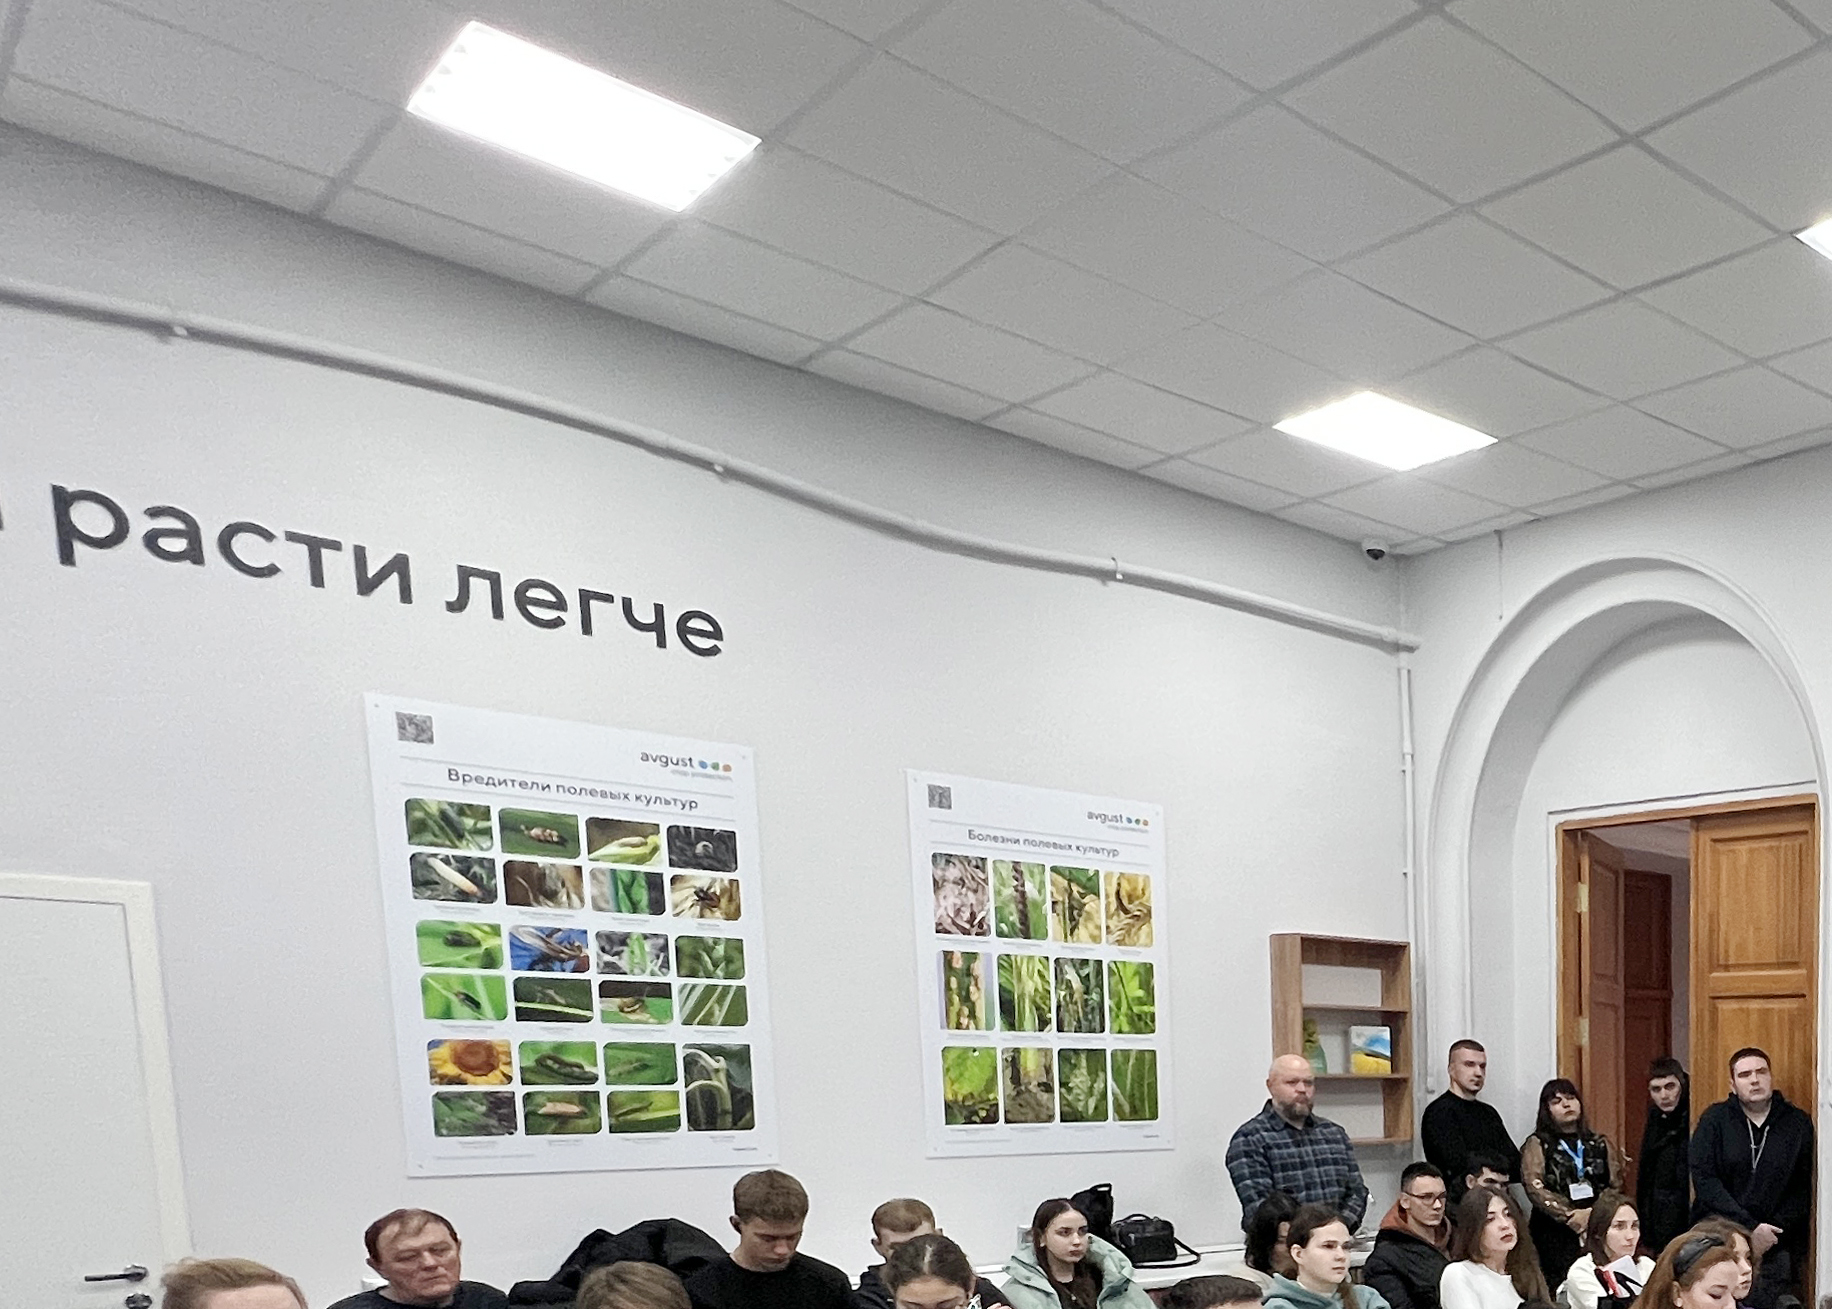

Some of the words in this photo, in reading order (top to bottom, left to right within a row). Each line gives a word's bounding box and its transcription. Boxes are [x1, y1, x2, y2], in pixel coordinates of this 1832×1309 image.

[50, 484, 413, 605] расти
[445, 564, 725, 658] легче
[640, 751, 696, 769] avgust
[447, 767, 552, 793] Вредители
[556, 784, 631, 802] полевых
[634, 793, 699, 811] культур
[1087, 811, 1124, 825] avgust
[967, 828, 1021, 846] Болезни
